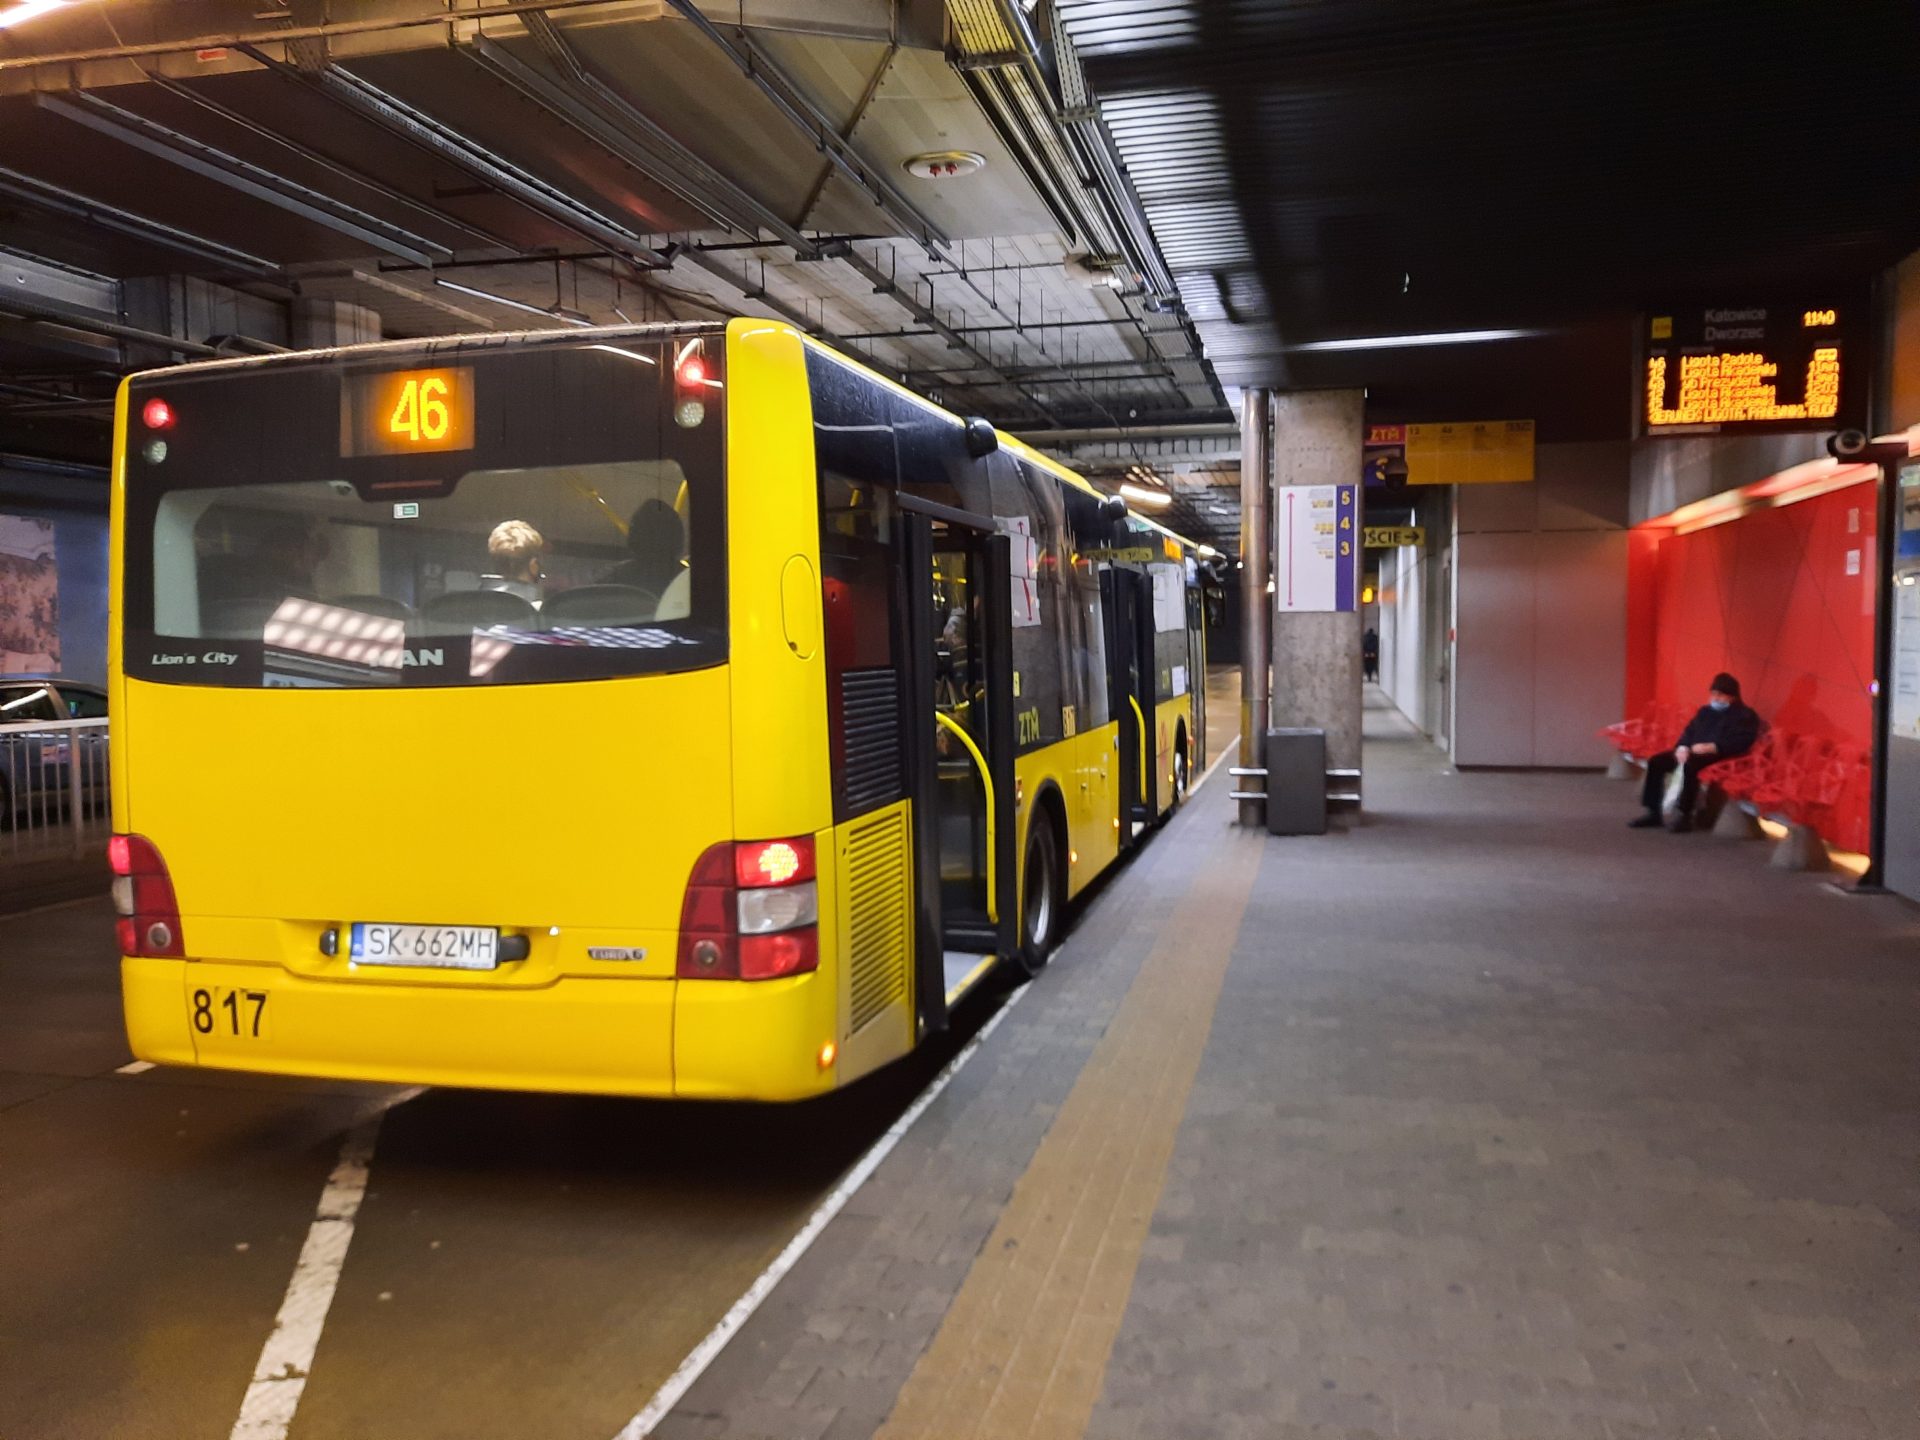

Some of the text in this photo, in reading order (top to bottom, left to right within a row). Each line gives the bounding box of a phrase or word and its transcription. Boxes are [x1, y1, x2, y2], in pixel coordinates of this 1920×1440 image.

[1705, 308, 1766, 322] Katowice
[1705, 327, 1765, 341] Dworzec
[1650, 357, 1666, 369] 46
[390, 378, 448, 440] 46
[1341, 490, 1351, 506] 5
[1340, 516, 1351, 530] 4
[1340, 541, 1350, 556] 3
[152, 651, 239, 665] Lion's City
[369, 928, 493, 959] SK 662MH
[194, 988, 266, 1037] 817
